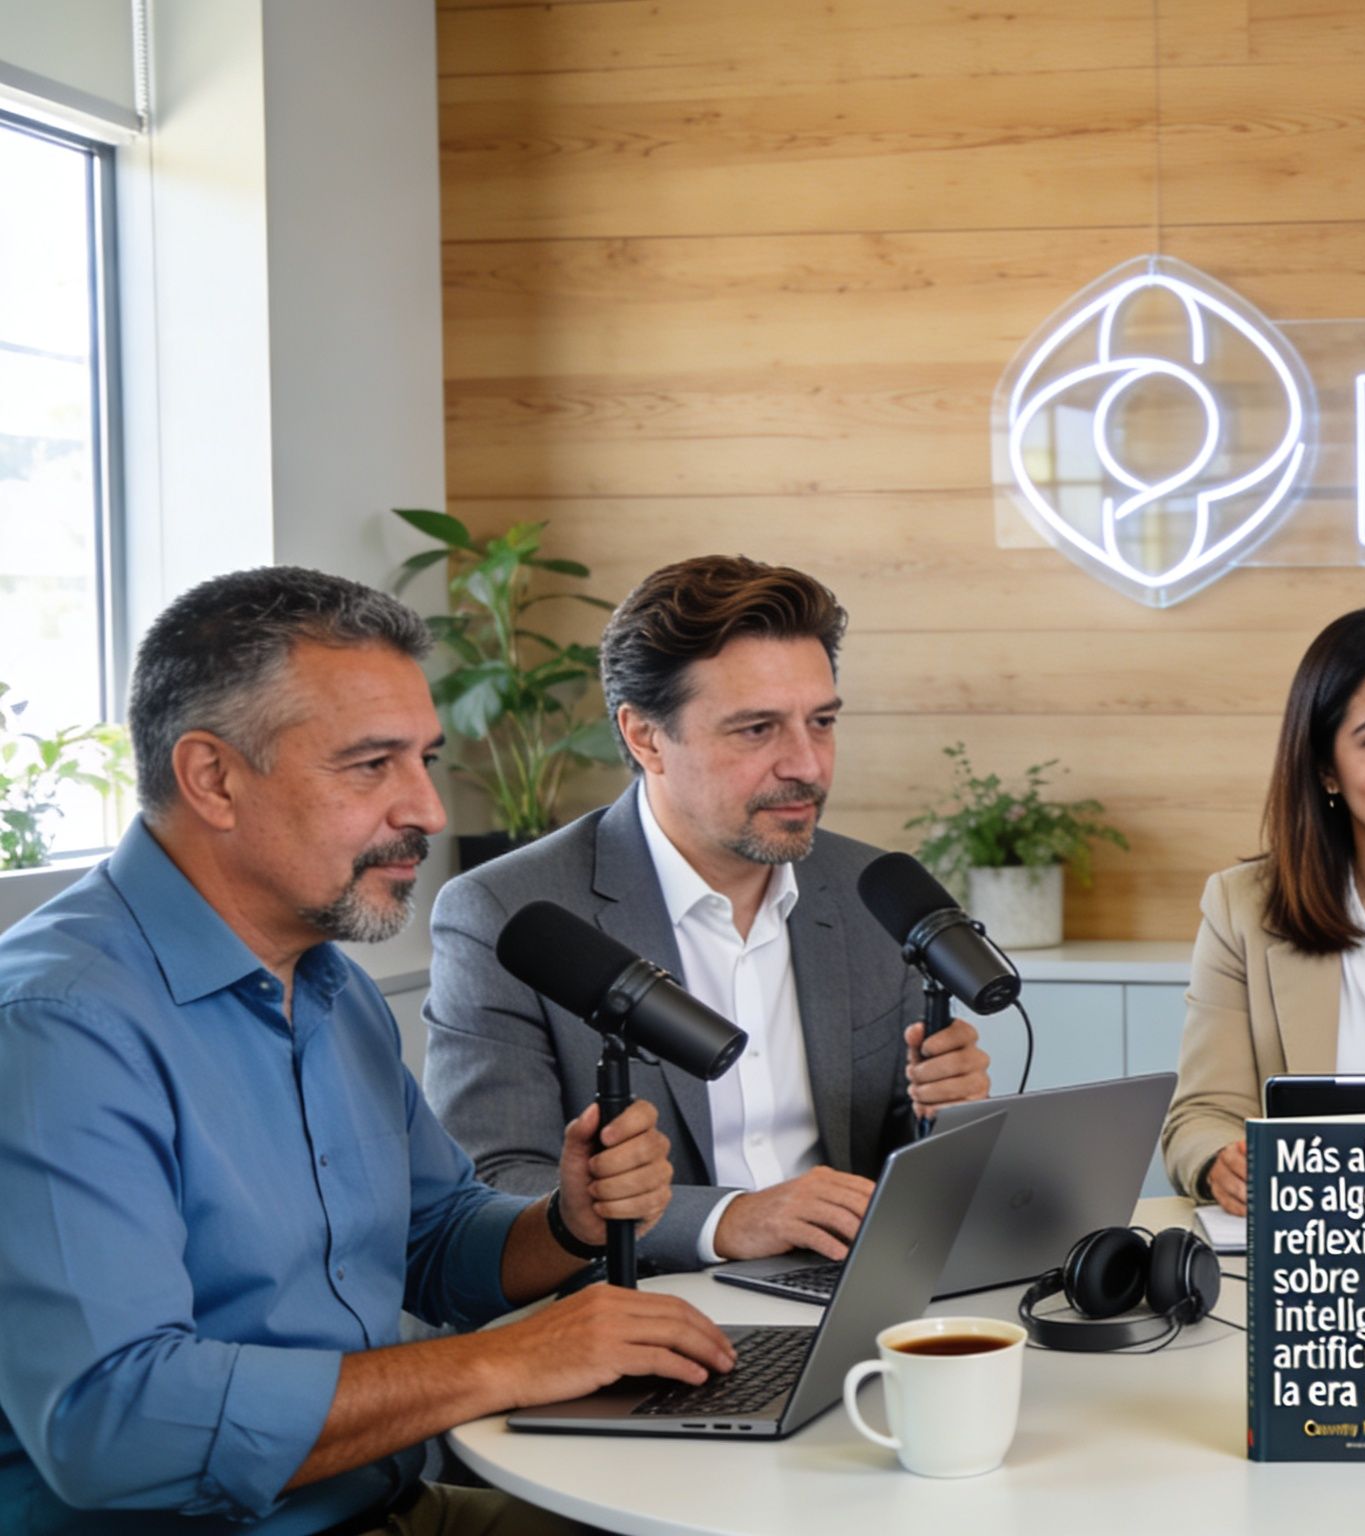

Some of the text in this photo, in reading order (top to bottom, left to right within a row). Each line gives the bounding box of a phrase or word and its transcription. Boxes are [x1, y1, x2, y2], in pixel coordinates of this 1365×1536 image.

[1277, 1135, 1341, 1174] Más
[1270, 1176, 1314, 1212] los
[1273, 1258, 1360, 1294] sobre
[1274, 1371, 1301, 1407] la
[1308, 1380, 1358, 1407] era
